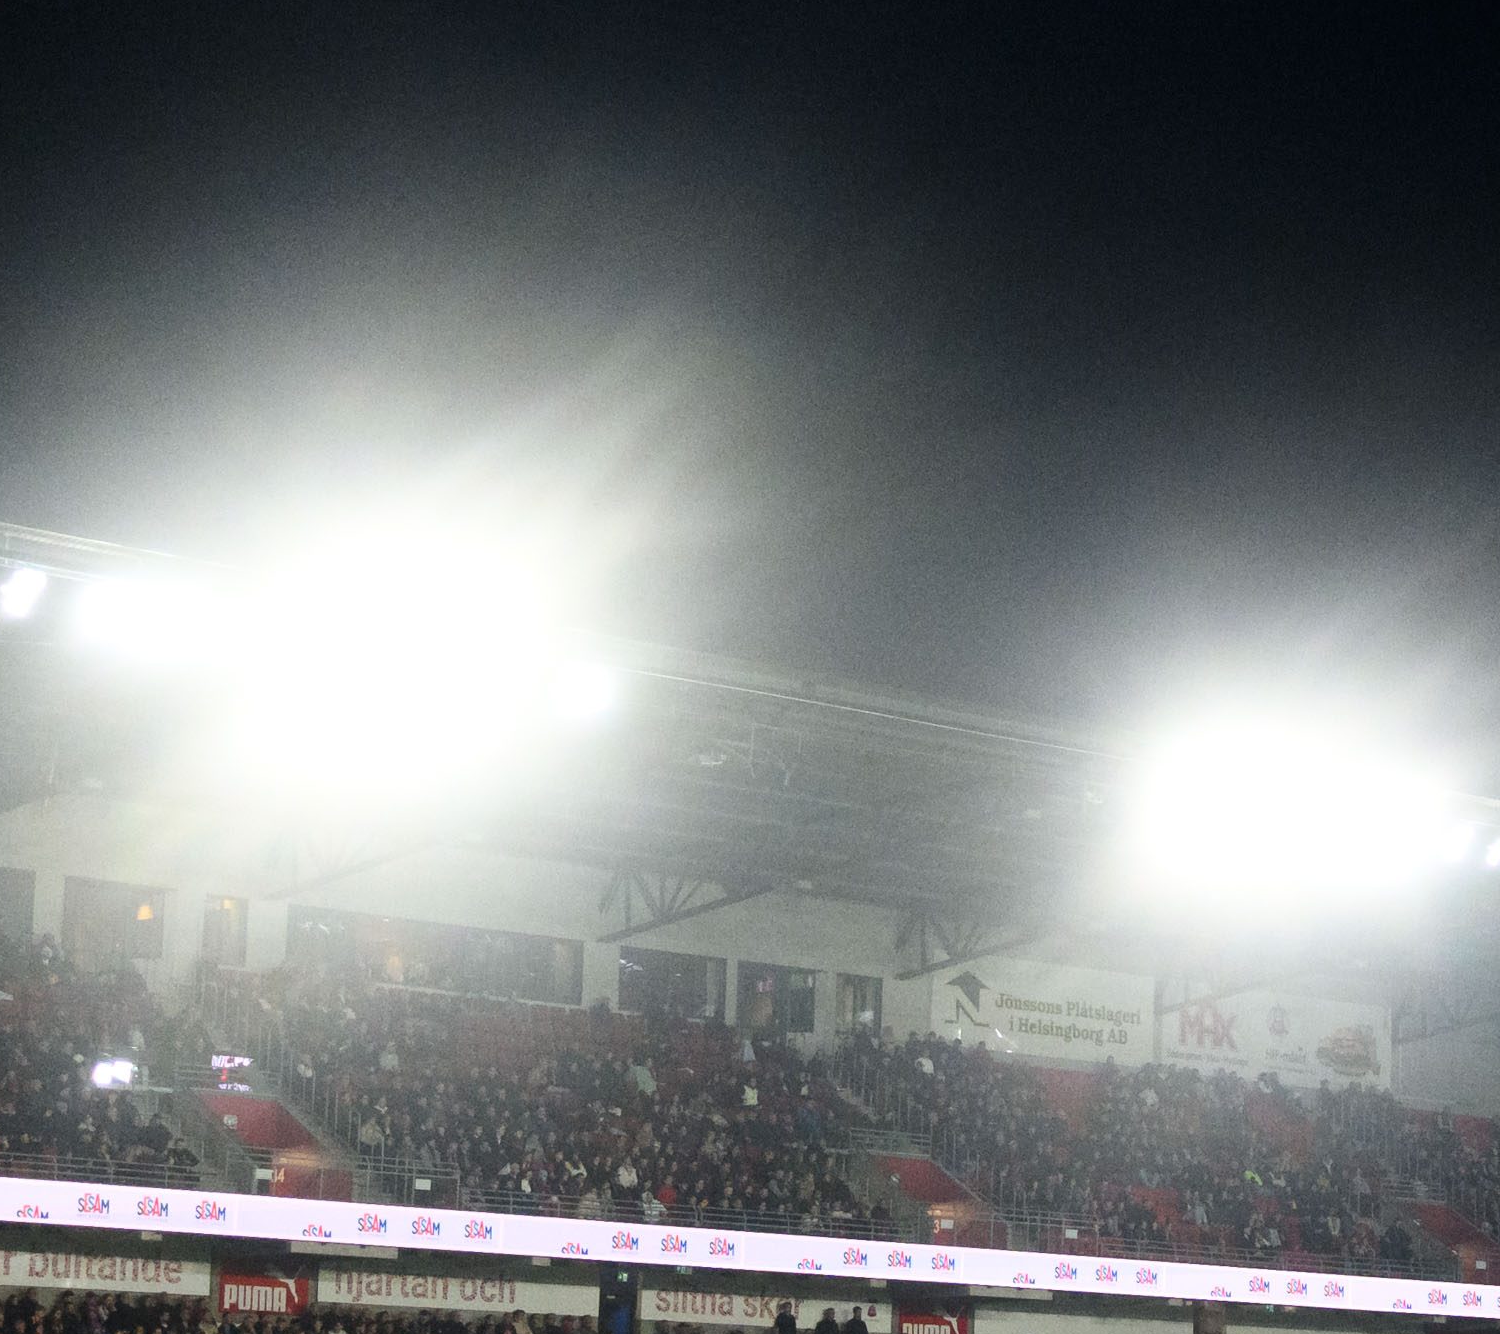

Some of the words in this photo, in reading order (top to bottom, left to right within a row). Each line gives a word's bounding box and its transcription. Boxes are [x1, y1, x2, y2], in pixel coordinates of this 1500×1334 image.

[994, 992, 1062, 1016] Jönssons
[1065, 999, 1142, 1027] Plåtslageri
[1008, 1017, 1015, 1032] i
[1018, 1018, 1104, 1047] Helsingborg
[1107, 1028, 1129, 1046] AB
[78, 1192, 109, 1214] SESAM
[138, 1197, 168, 1217] SESAM
[196, 1201, 226, 1221] SESAM
[223, 1284, 287, 1313] PUMA
